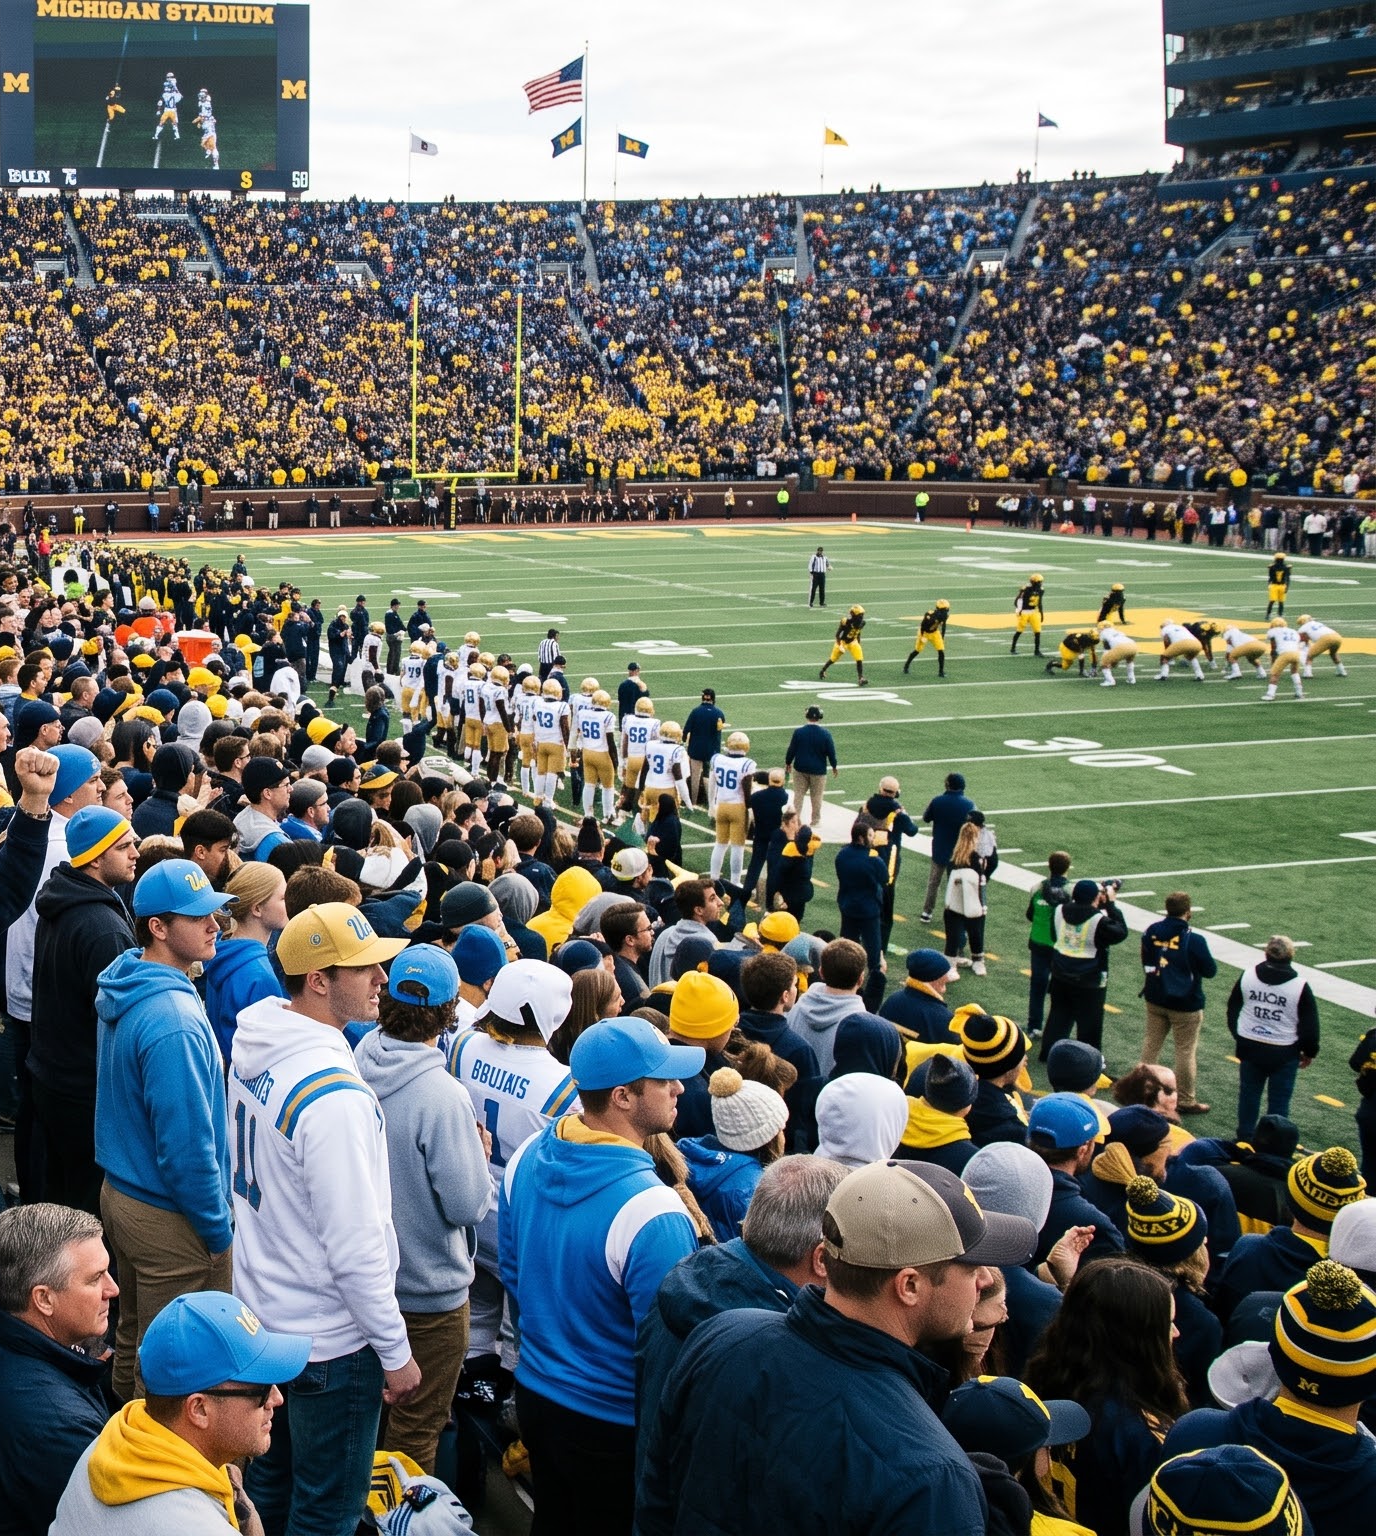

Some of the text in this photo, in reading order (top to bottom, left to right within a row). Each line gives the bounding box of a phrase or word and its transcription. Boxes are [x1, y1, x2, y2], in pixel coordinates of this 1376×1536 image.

[36, 0, 274, 25] MICHIGAN STADIUM
[2, 72, 30, 93] M
[281, 79, 307, 100] M
[716, 767, 738, 790] 36
[1297, 1376, 1321, 1396] M
